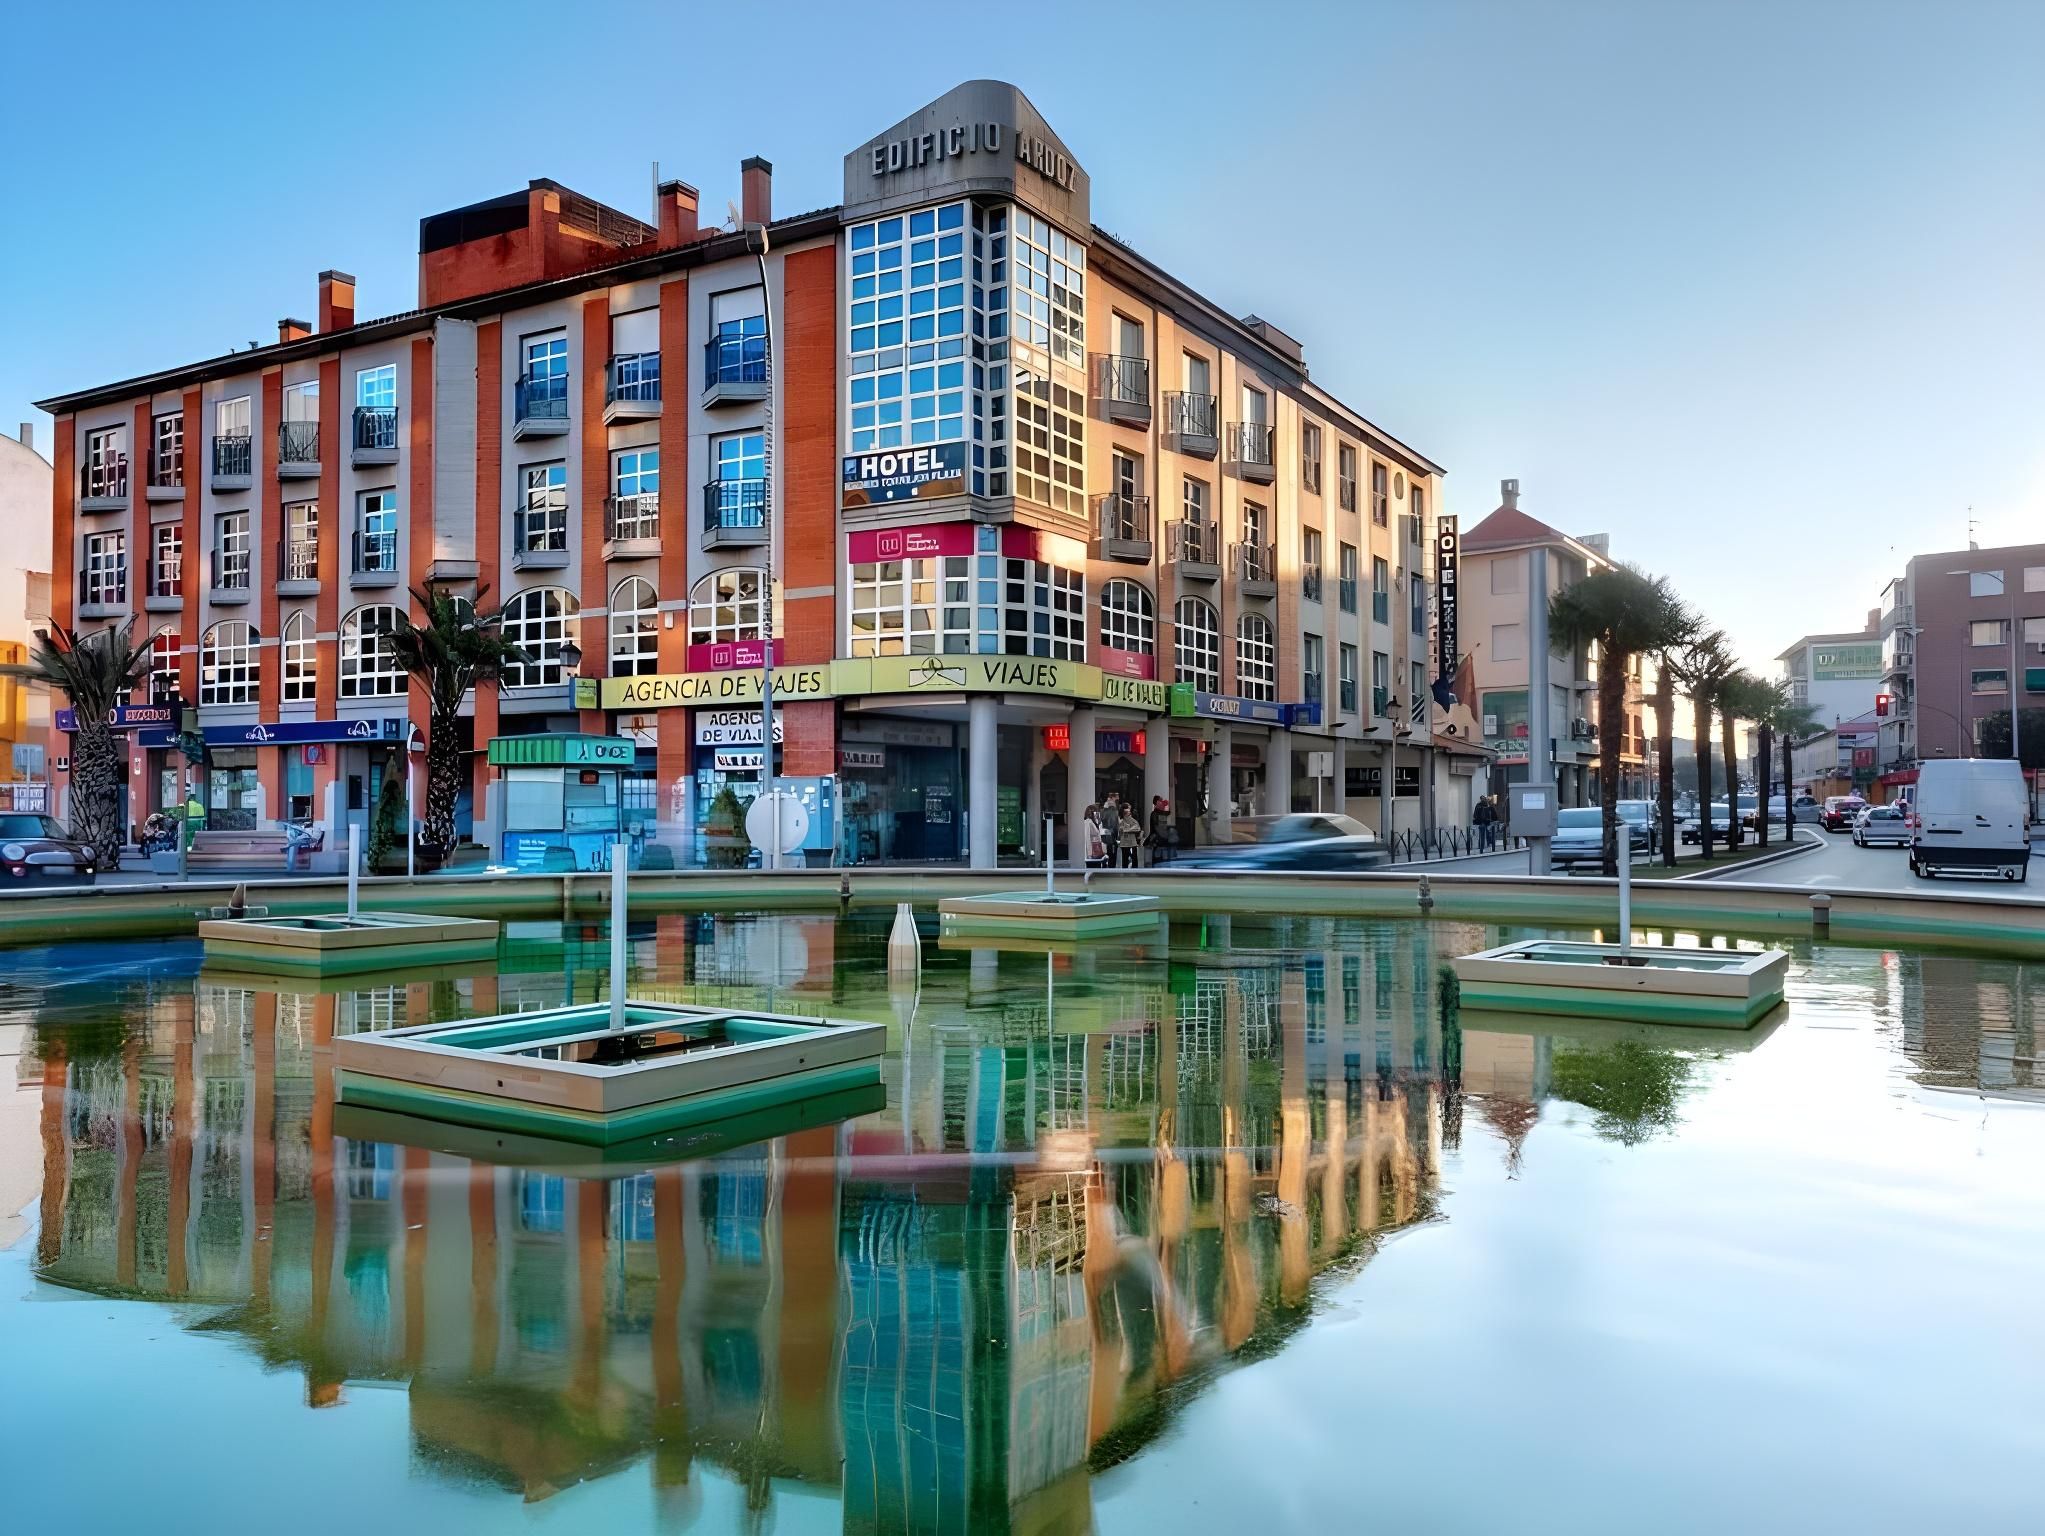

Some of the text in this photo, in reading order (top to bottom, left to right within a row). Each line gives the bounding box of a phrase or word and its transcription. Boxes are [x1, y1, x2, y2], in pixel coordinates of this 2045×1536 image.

[871, 121, 1001, 176] EDIFICIO
[861, 447, 945, 480] HOTEL
[1441, 517, 1454, 601] HOTEL
[622, 677, 712, 703] AGENCIA
[720, 676, 746, 697] DE
[753, 671, 821, 695] VAJES
[983, 660, 1058, 689] VIAJES
[702, 726, 782, 742] DE VIAJS
[709, 712, 776, 726] AGENC
